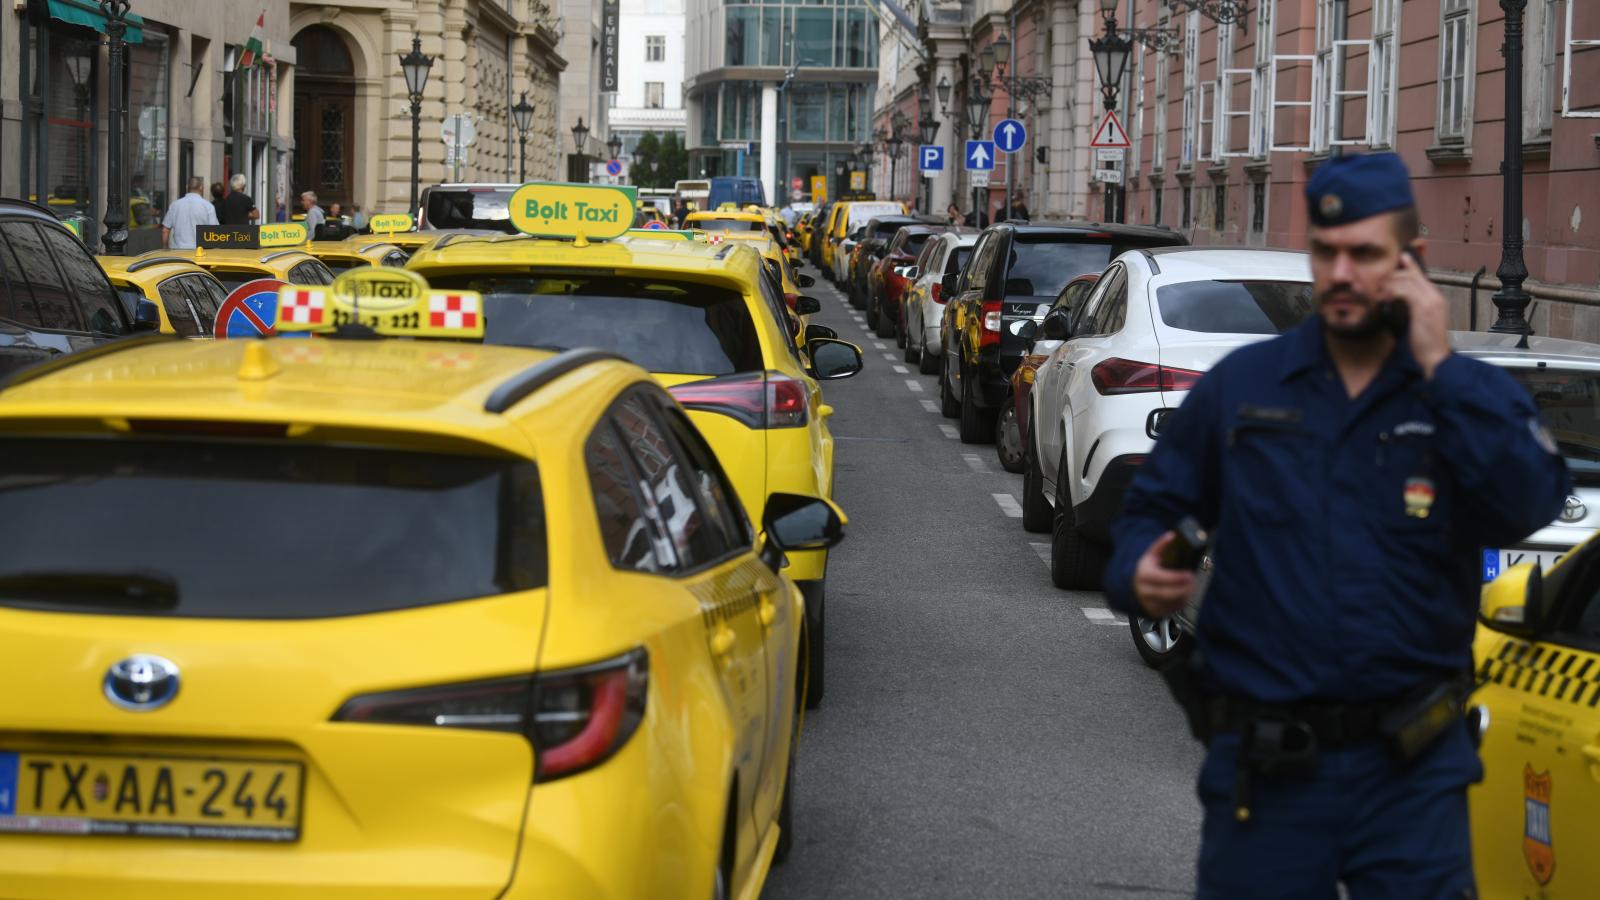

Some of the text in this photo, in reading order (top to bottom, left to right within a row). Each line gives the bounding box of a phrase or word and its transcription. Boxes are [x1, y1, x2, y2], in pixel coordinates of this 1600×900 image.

[605, 15, 616, 87] EMERALD
[924, 148, 939, 168] P
[525, 199, 618, 225] Bolt Taxi
[203, 231, 251, 242] Uber Taxi
[261, 229, 300, 242] Bolt Taxi
[28, 761, 287, 819] TX AA-244
